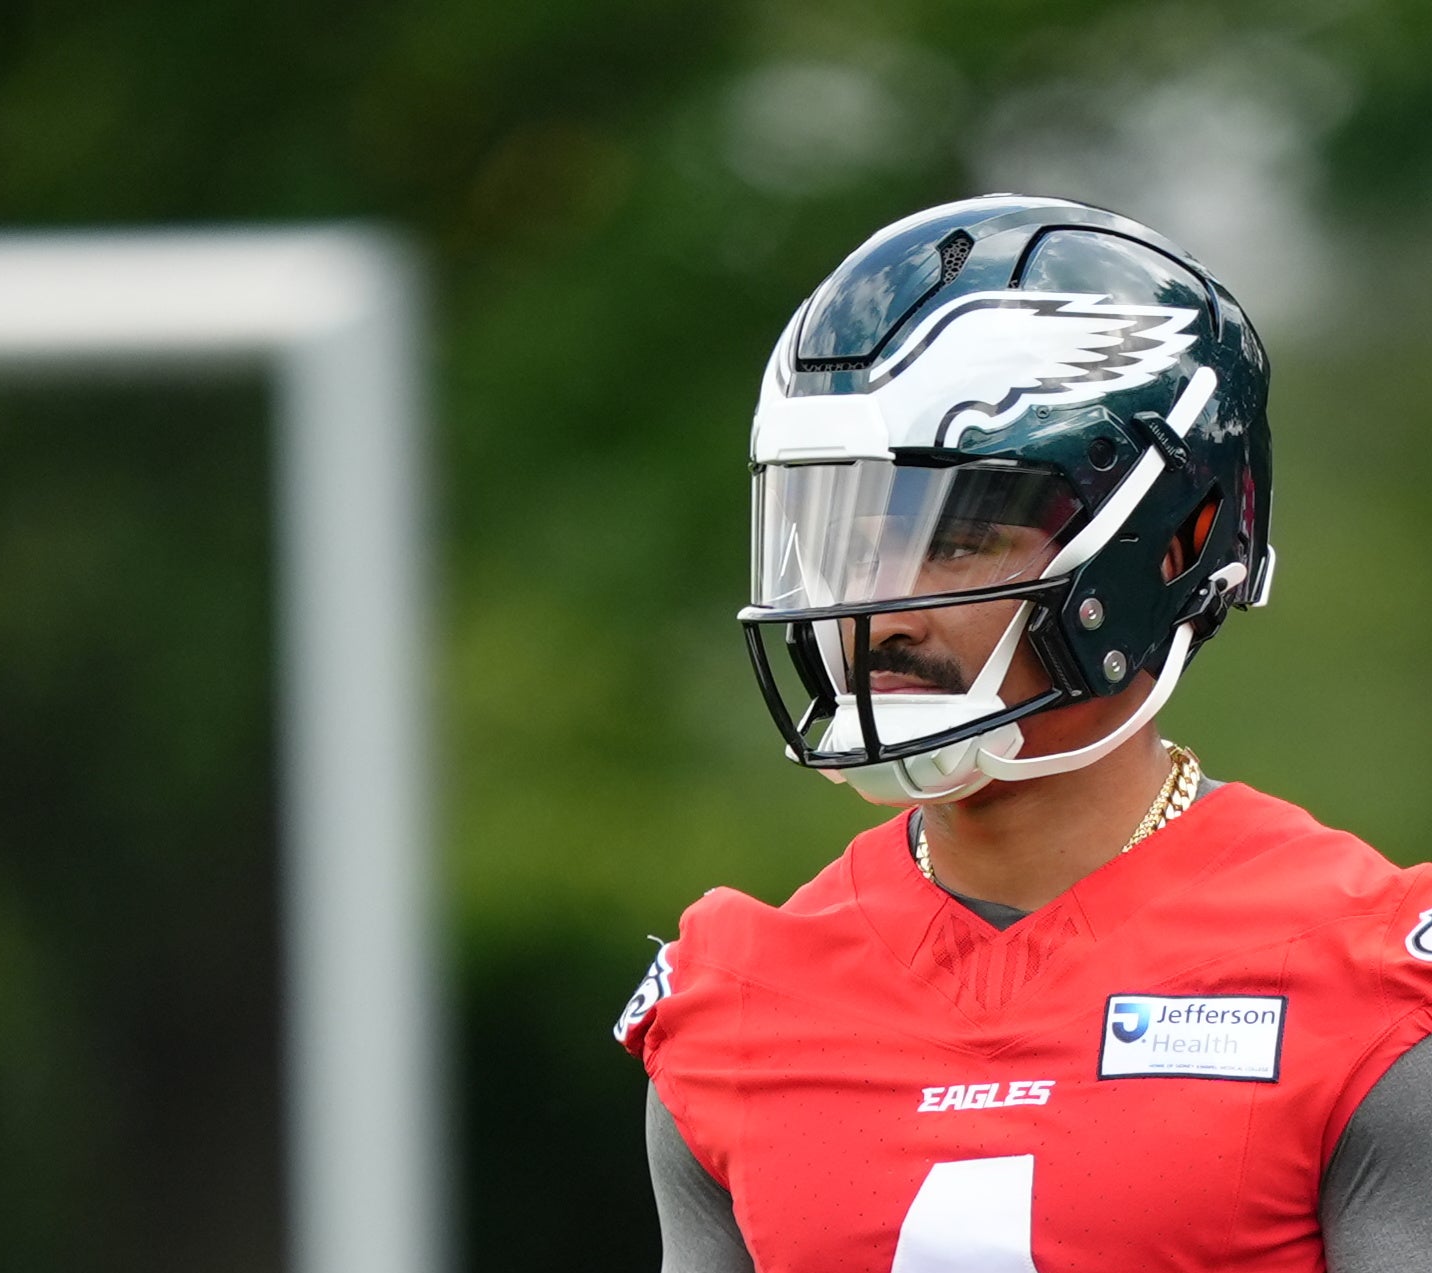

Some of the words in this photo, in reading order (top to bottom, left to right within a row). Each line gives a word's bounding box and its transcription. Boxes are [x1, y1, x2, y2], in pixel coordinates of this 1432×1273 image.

[1156, 1003, 1276, 1024] Jefferson
[1151, 1033, 1238, 1054] Health
[916, 1080, 1057, 1113] EAGLES
